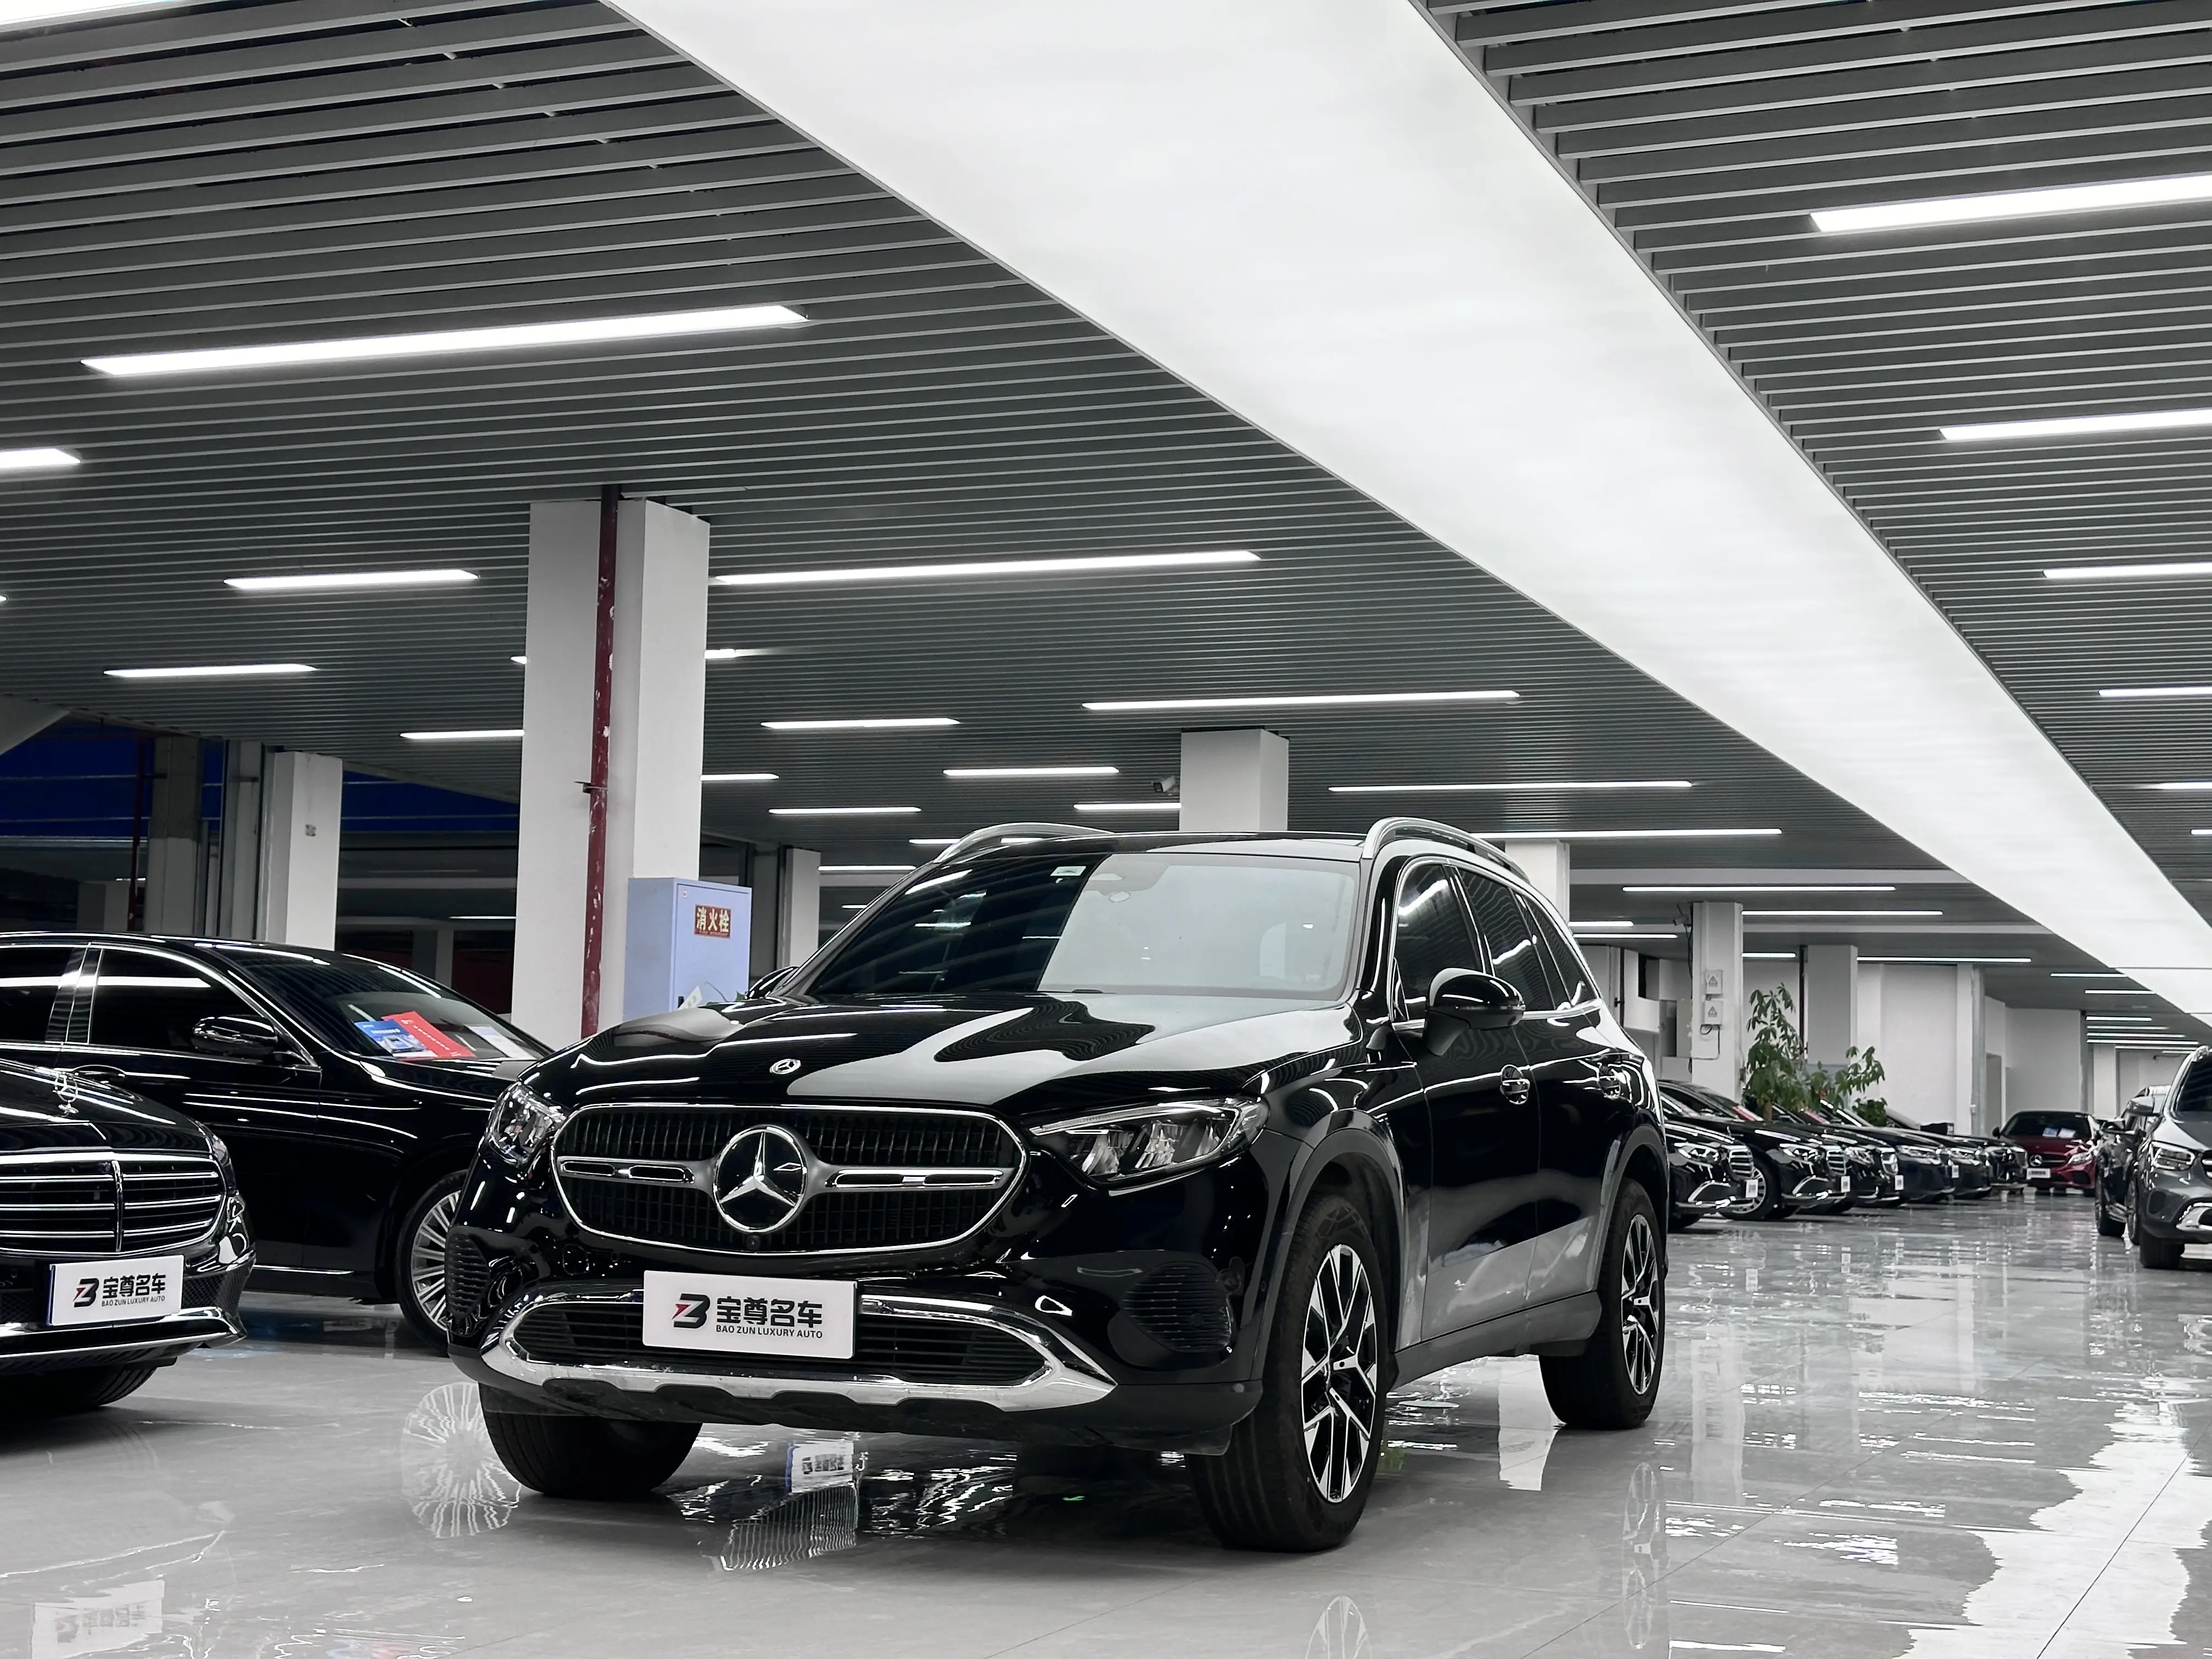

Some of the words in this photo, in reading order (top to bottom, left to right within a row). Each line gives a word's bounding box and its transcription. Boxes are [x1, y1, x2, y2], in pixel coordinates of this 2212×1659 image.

[696, 906, 730, 933] 消火栓
[102, 1273, 166, 1299] 宝尊名车
[716, 1296, 822, 1328] 宝尊名车
[716, 1325, 735, 1333] BAO
[736, 1326, 755, 1334] ZUN
[758, 1327, 795, 1336] LUXURY
[797, 1330, 822, 1339] AUTO
